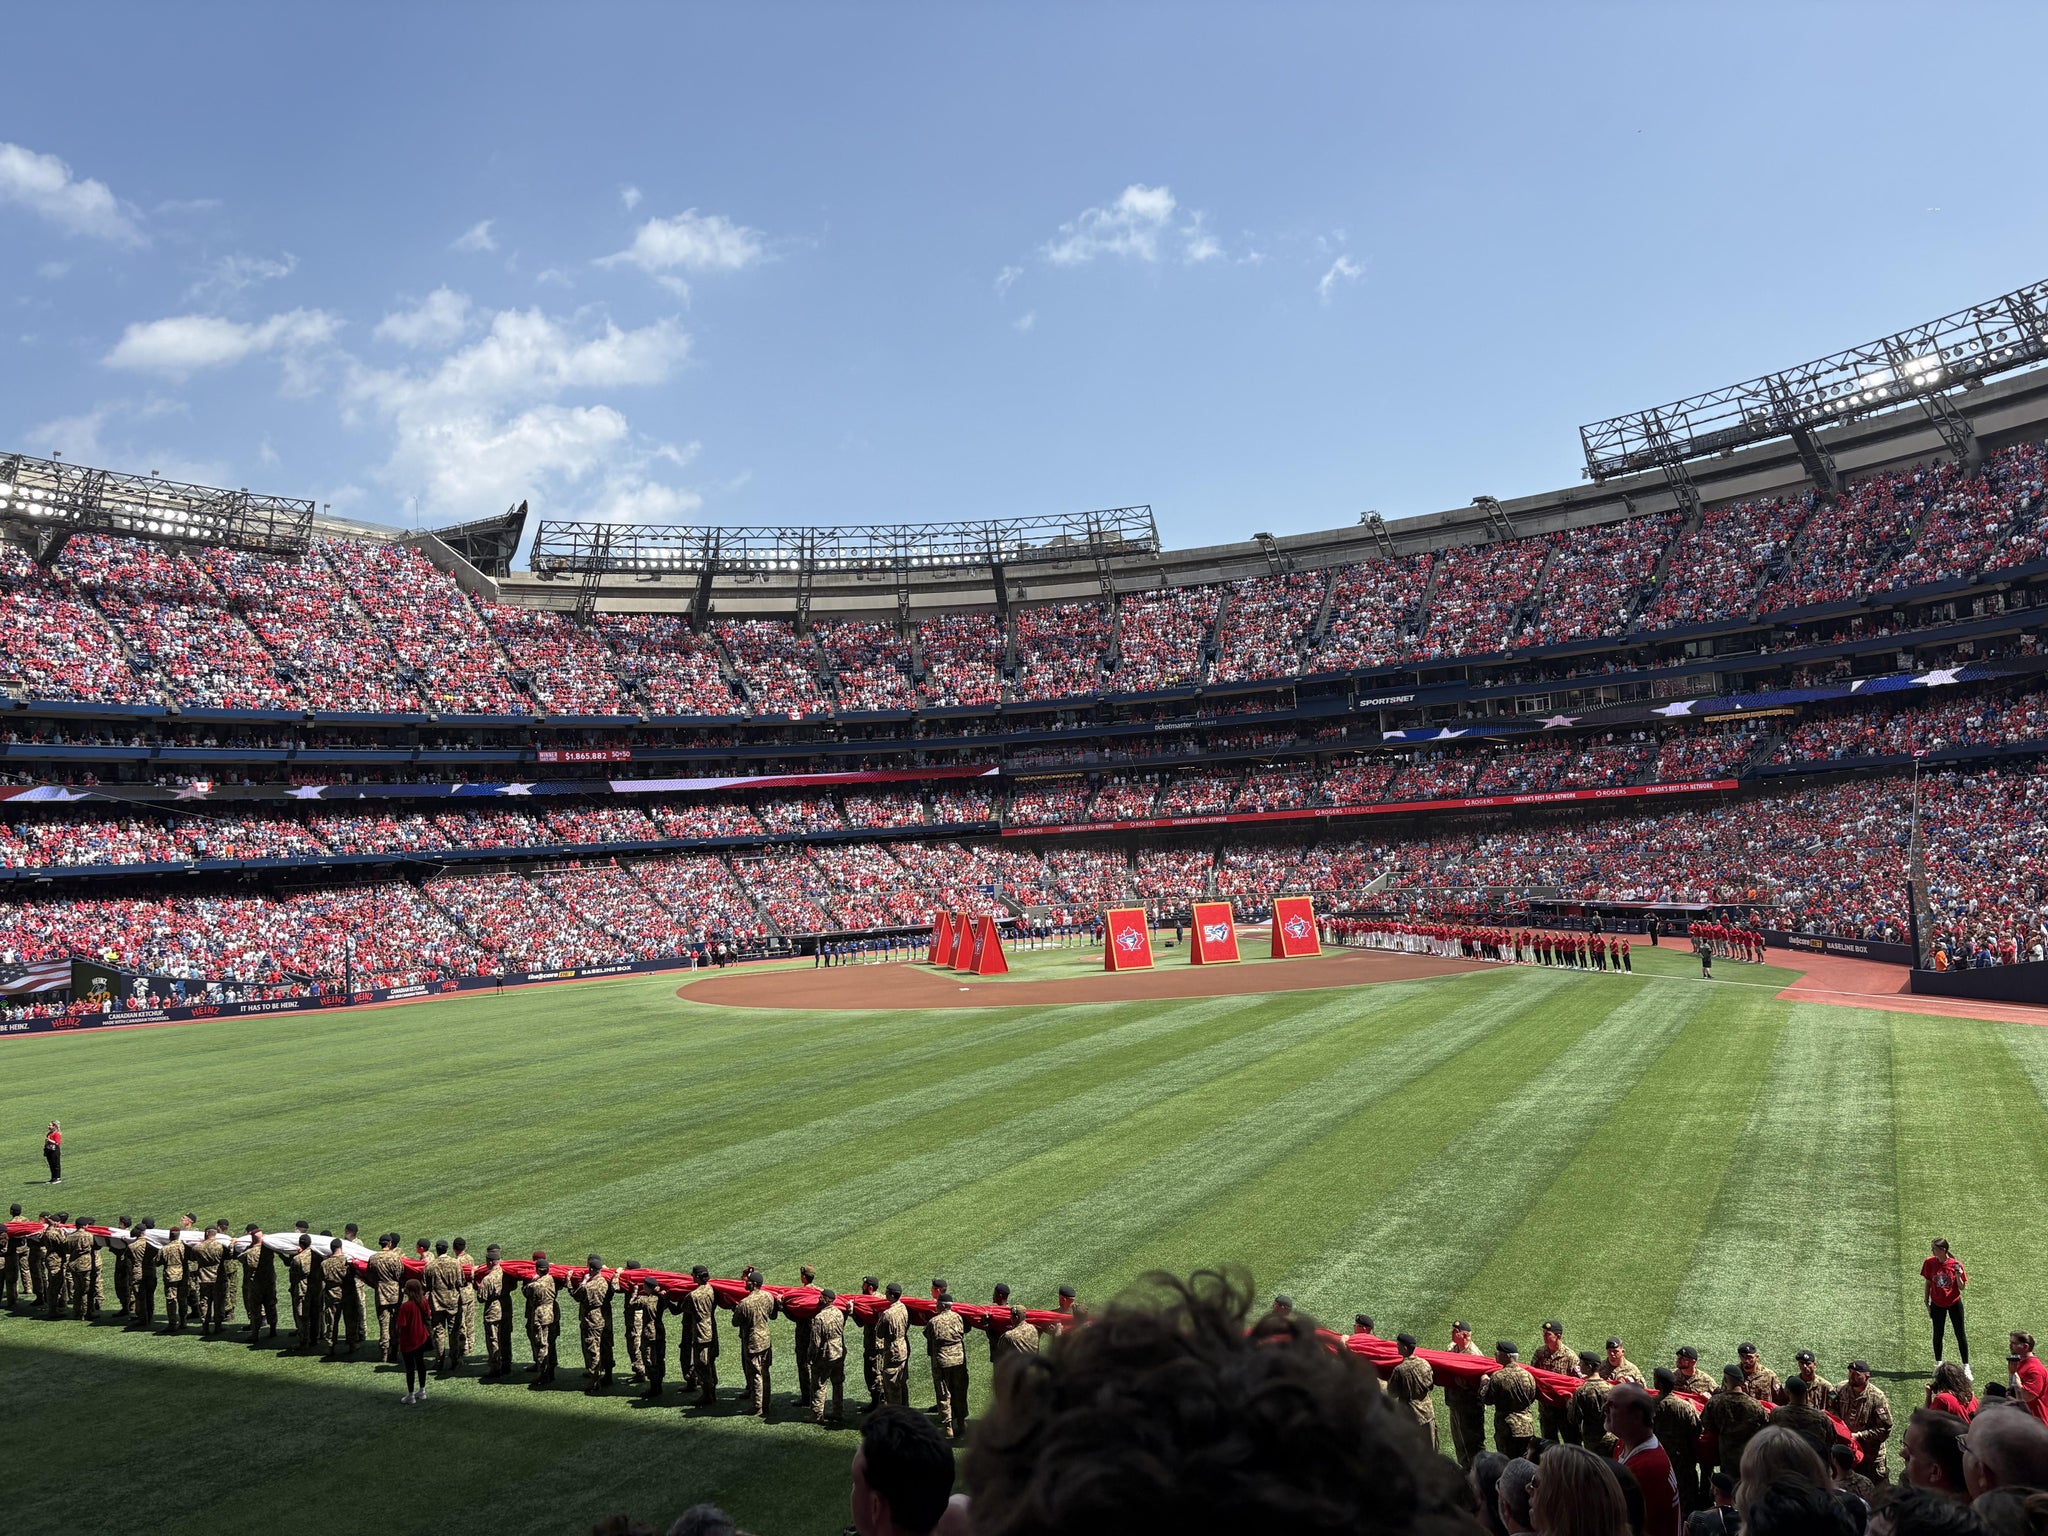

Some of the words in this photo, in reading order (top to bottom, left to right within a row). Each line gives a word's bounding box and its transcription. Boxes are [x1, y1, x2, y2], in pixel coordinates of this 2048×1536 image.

[1360, 694, 1415, 706] SPORTSNET
[1154, 722, 1192, 730] ticketmaster
[1827, 942, 1854, 952] BASELINE
[582, 967, 616, 975] BASELINE
[92, 977, 108, 985] HEINZ
[441, 981, 459, 990] HEINZ
[320, 996, 348, 1005] HEINZ
[354, 992, 374, 1002] HEINZ
[191, 1006, 221, 1017] HEINZ
[51, 1017, 82, 1028] HEINZ
